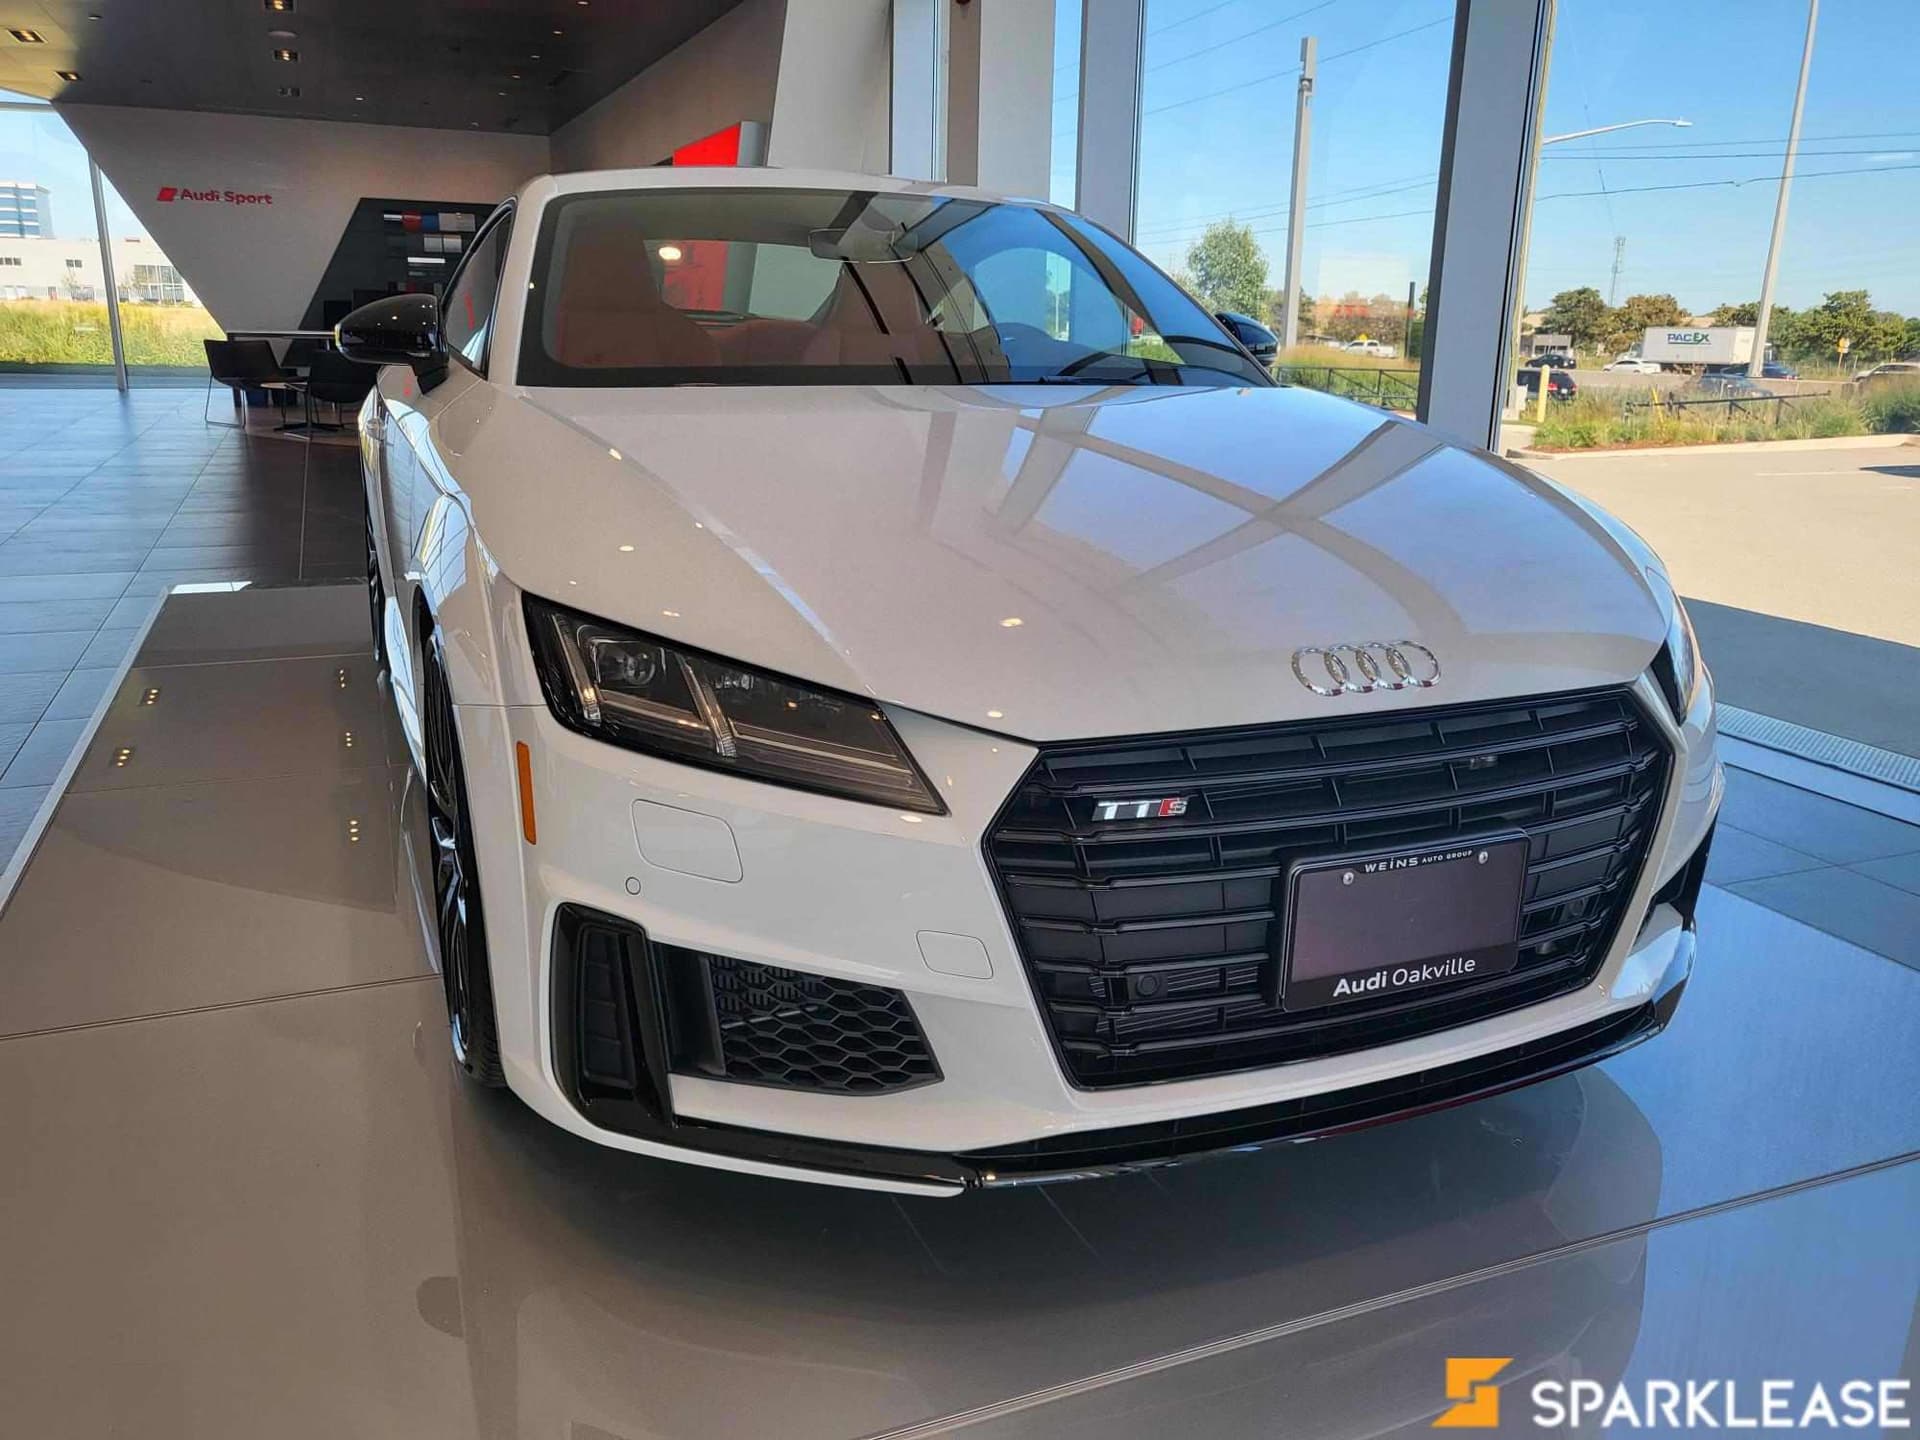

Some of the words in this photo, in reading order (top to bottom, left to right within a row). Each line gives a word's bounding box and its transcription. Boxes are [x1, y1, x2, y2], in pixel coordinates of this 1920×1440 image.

[180, 189, 220, 201] Audi
[223, 191, 273, 205] Sport
[1097, 798, 1188, 820] TTS
[1421, 854, 1444, 864] AUTO
[1446, 849, 1473, 860] GROUP
[1332, 970, 1388, 998] Audi
[1392, 957, 1477, 986] Oakville
